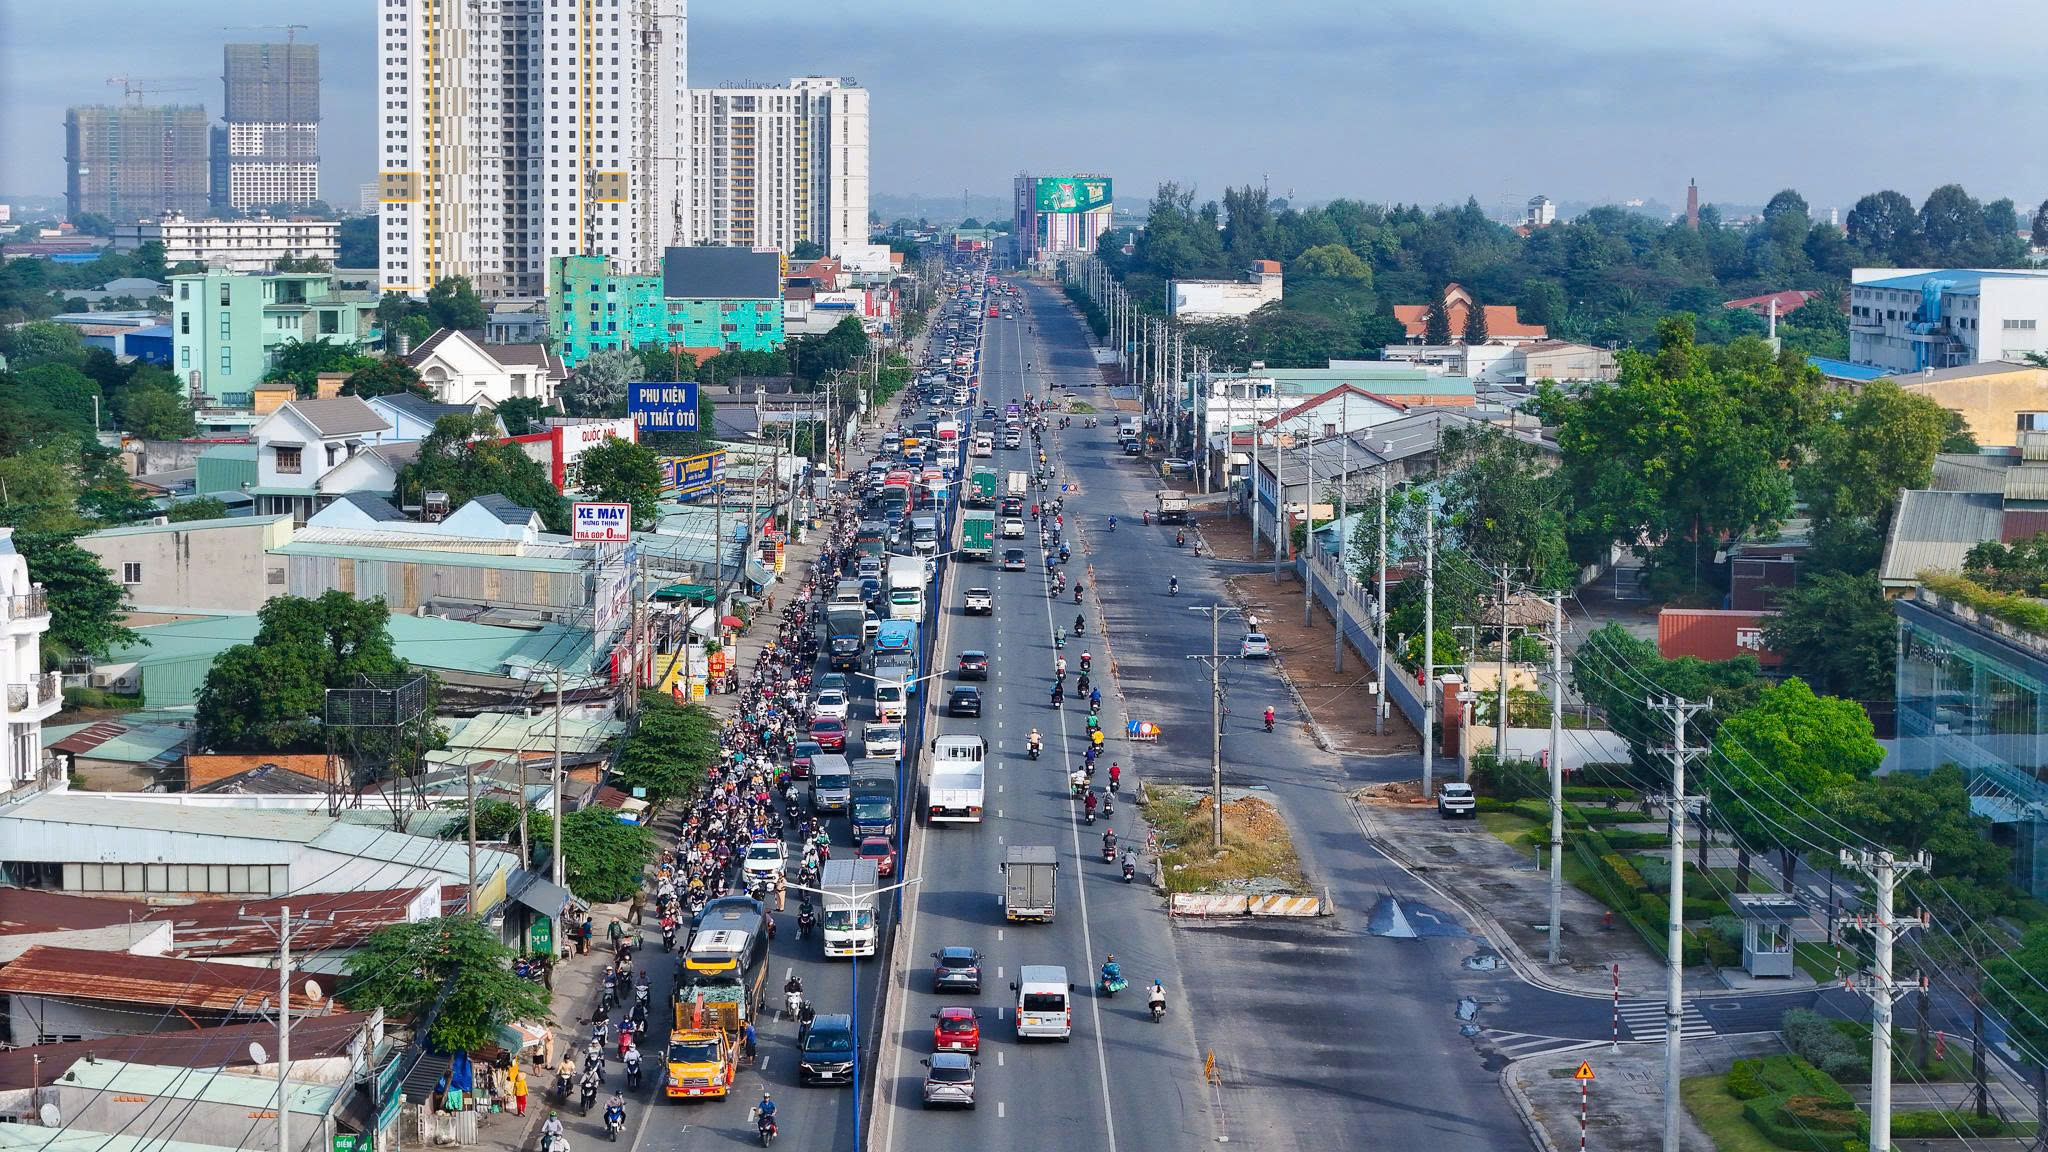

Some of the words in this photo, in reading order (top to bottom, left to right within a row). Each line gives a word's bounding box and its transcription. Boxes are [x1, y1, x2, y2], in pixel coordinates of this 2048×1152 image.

[719, 79, 770, 89] citadines
[639, 388, 660, 406] PHỤ
[662, 386, 686, 406] KIỆN
[650, 406, 674, 427] THẤT
[676, 409, 695, 427] ÔTÔ
[582, 427, 601, 442] QUỐC
[578, 507, 594, 519] XE
[598, 506, 625, 519] MÁY
[591, 530, 605, 539] GÓP
[606, 527, 614, 539] 0
